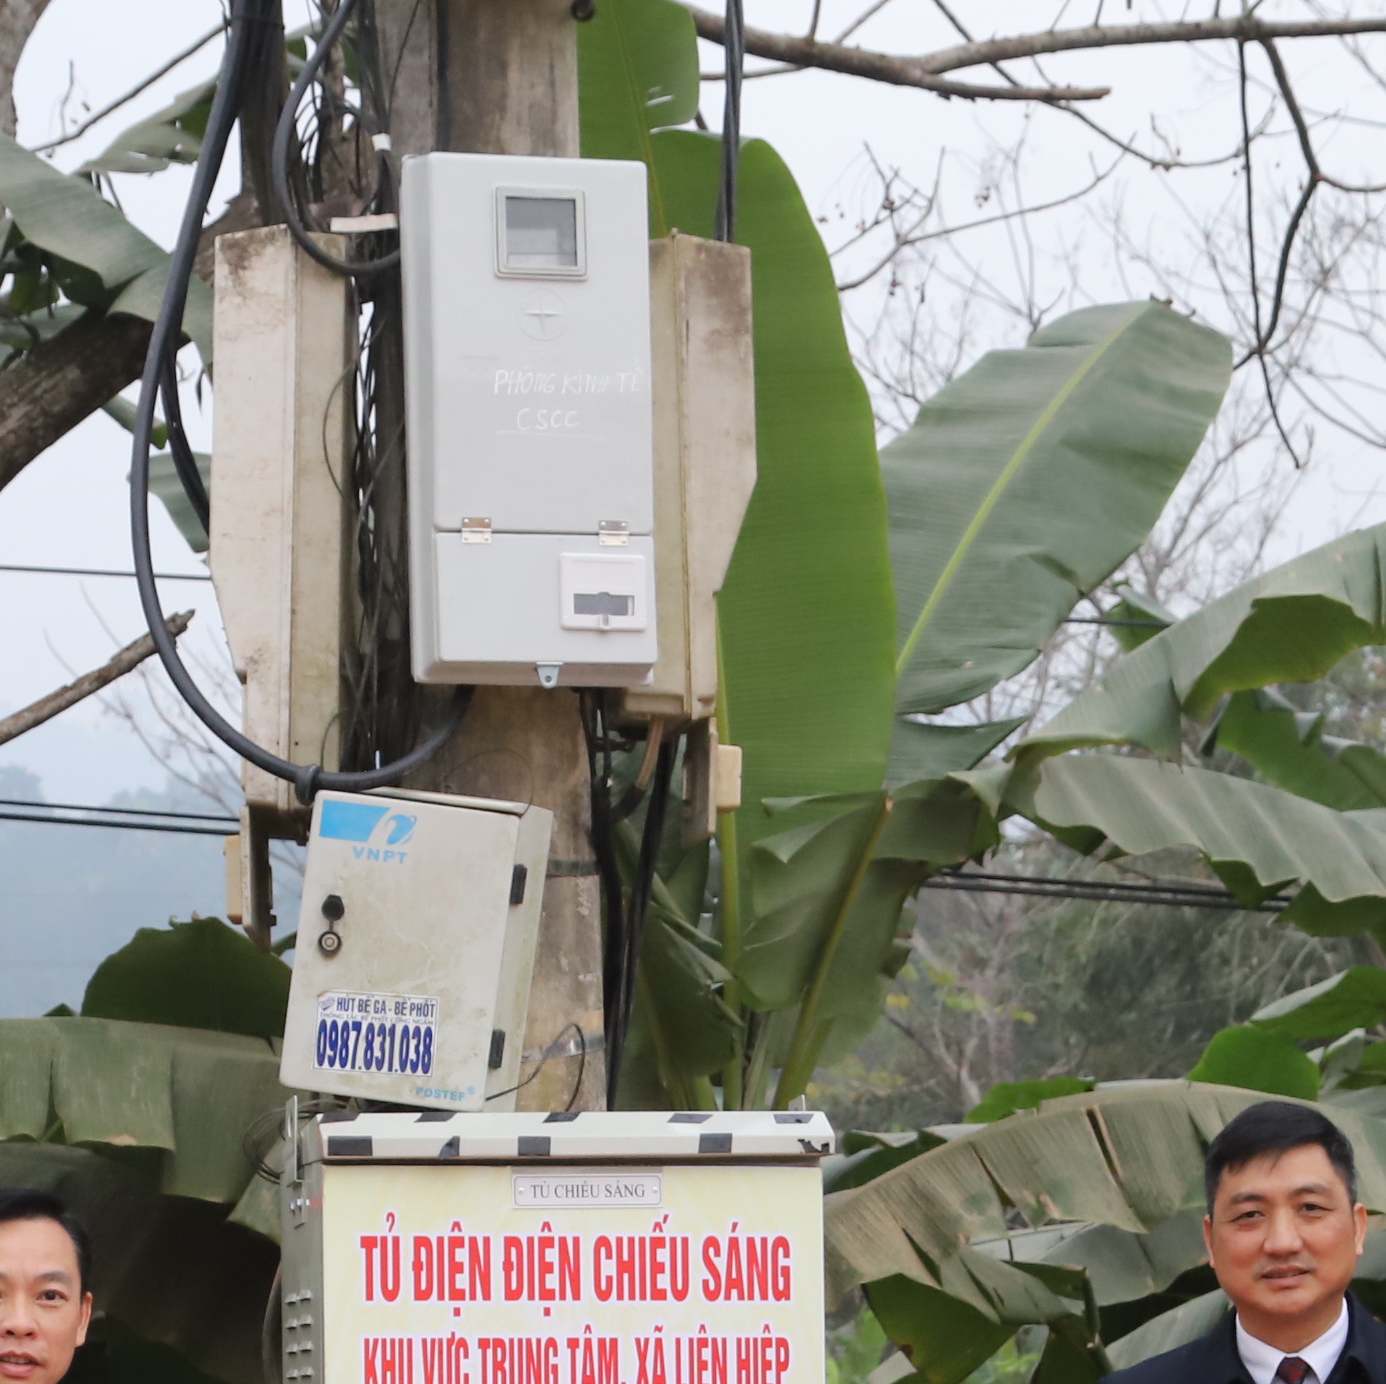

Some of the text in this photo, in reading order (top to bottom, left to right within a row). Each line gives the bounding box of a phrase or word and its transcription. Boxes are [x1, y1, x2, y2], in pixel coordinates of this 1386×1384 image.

[516, 408, 580, 430] CSCC
[352, 846, 409, 864] VNPT
[316, 1018, 433, 1075] 0987.831.038
[416, 1087, 466, 1101] POSTEF
[530, 1179, 645, 1199] TỦ CHIẾU SÁNG
[360, 1212, 791, 1317] TỦ ĐIỆN ĐIỆN CHIẾU SÁNG
